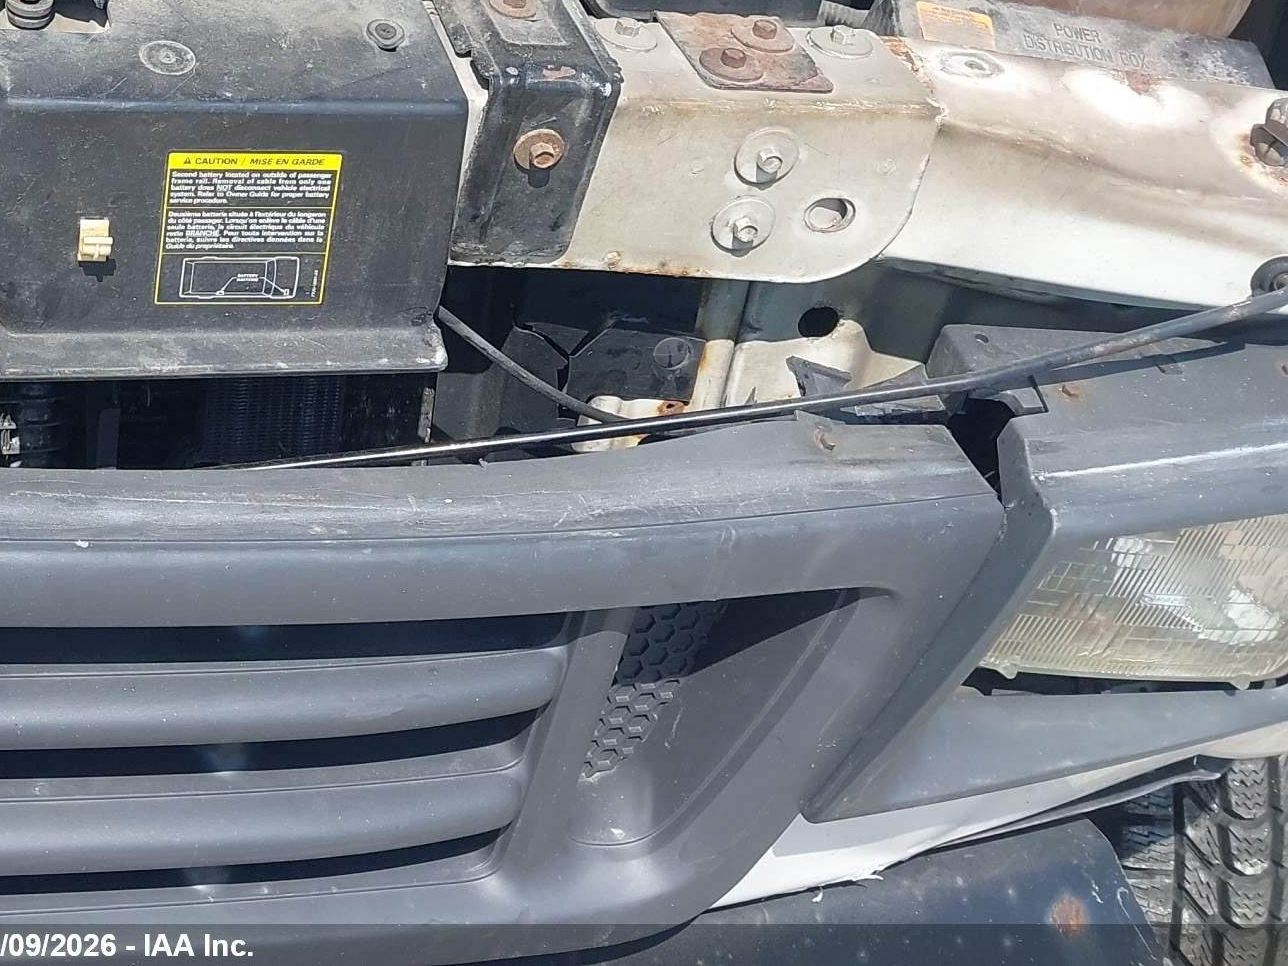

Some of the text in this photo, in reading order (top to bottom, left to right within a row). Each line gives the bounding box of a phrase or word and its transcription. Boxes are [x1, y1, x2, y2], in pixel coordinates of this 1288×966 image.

[1054, 22, 1103, 44] POWER
[1023, 34, 1113, 63] DISTRIBUTION
[195, 157, 238, 165] CAUTION
